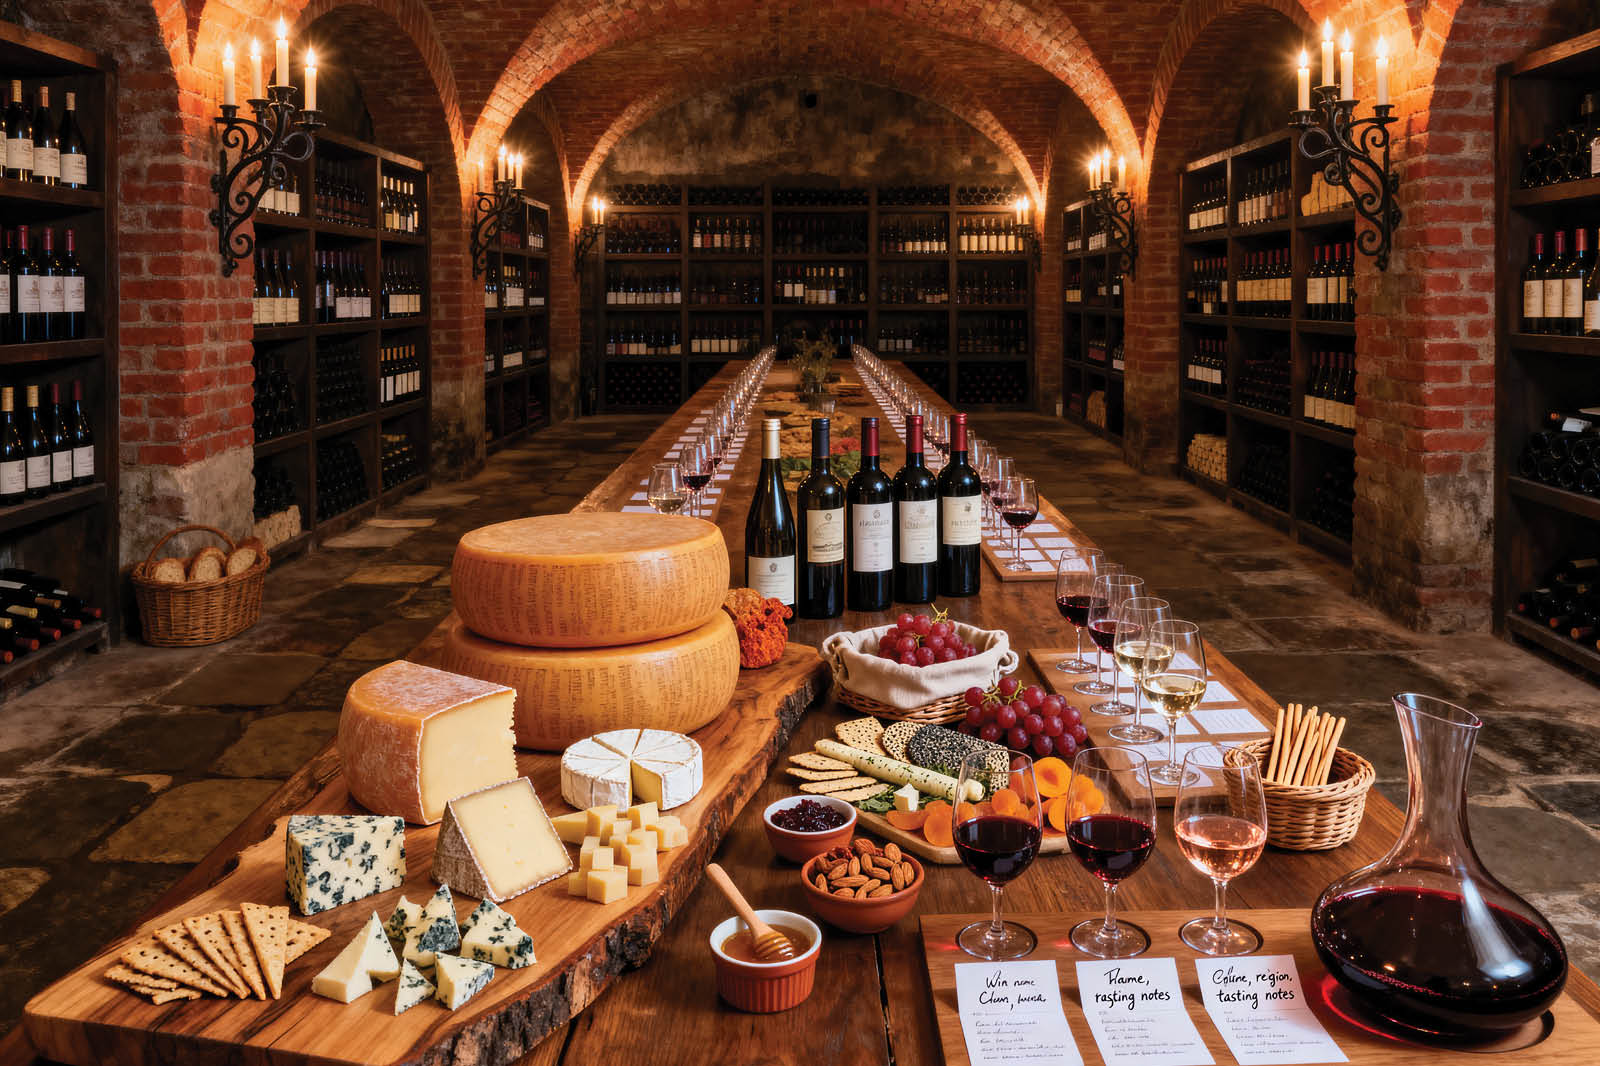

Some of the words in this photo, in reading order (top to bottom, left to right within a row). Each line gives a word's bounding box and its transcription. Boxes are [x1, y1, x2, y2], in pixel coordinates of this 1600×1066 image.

[1141, 988, 1171, 1001] notes
[1216, 988, 1258, 1009] tasting
[1265, 988, 1295, 1001] notes
